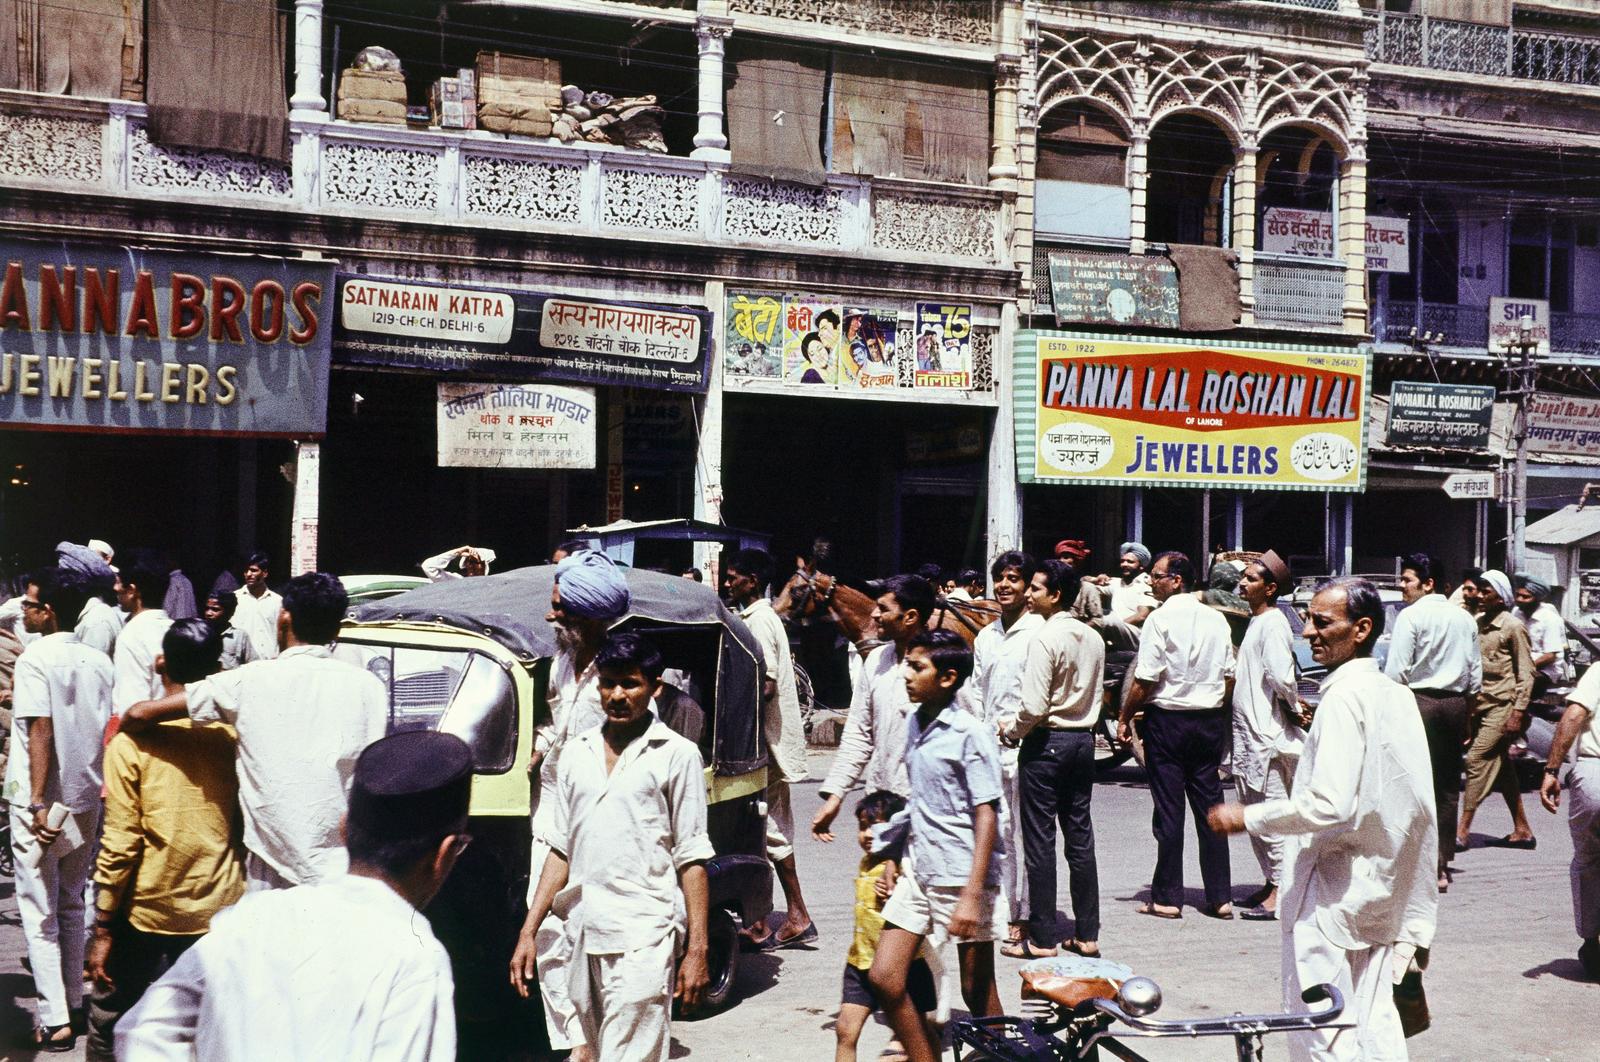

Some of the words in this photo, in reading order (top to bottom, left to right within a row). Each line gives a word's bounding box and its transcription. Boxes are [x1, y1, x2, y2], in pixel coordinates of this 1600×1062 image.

[344, 284, 439, 312] SATNARAIN
[448, 295, 505, 318] KATRA
[787, 305, 813, 332] बेटी
[940, 306, 970, 339] 75
[1048, 342, 1070, 351] ESTD.
[1075, 344, 1096, 353] 1922
[1045, 360, 1134, 411] PANNA
[1139, 367, 1191, 413] LAL
[1198, 369, 1307, 418] ROSHAN
[1308, 376, 1356, 420] LAL
[507, 414, 514, 426] व
[1185, 417, 1196, 425] OF
[467, 428, 494, 441] मिल
[502, 432, 513, 441] व
